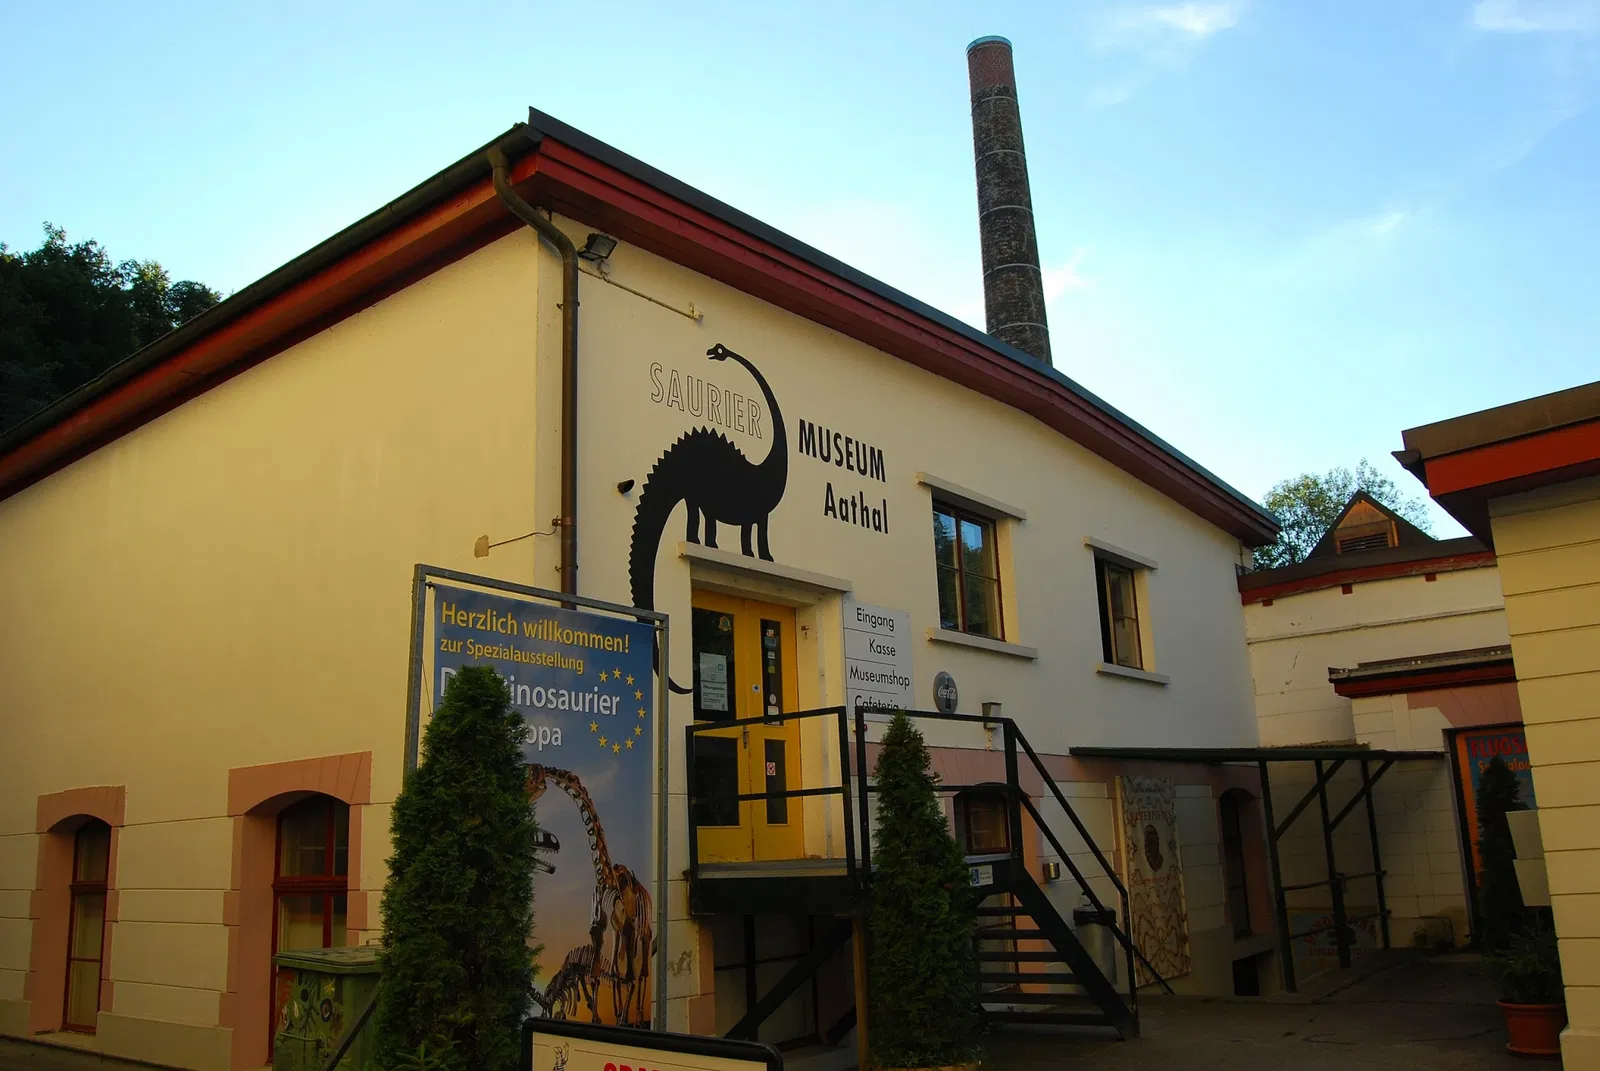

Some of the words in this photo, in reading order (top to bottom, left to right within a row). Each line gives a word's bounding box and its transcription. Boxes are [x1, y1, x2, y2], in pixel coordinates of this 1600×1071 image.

[649, 361, 763, 440] SAURIER
[798, 418, 886, 483] MUSEUM
[823, 482, 889, 535] Aathal
[441, 601, 518, 636] Herzlich
[523, 619, 630, 653] willkommen!
[856, 607, 895, 632] Eingang
[440, 637, 463, 654] zur
[466, 638, 584, 675] Spezialausstellung
[869, 638, 896, 657] Kasse
[508, 675, 621, 716] inosaurier
[849, 665, 910, 691] Museumshop
